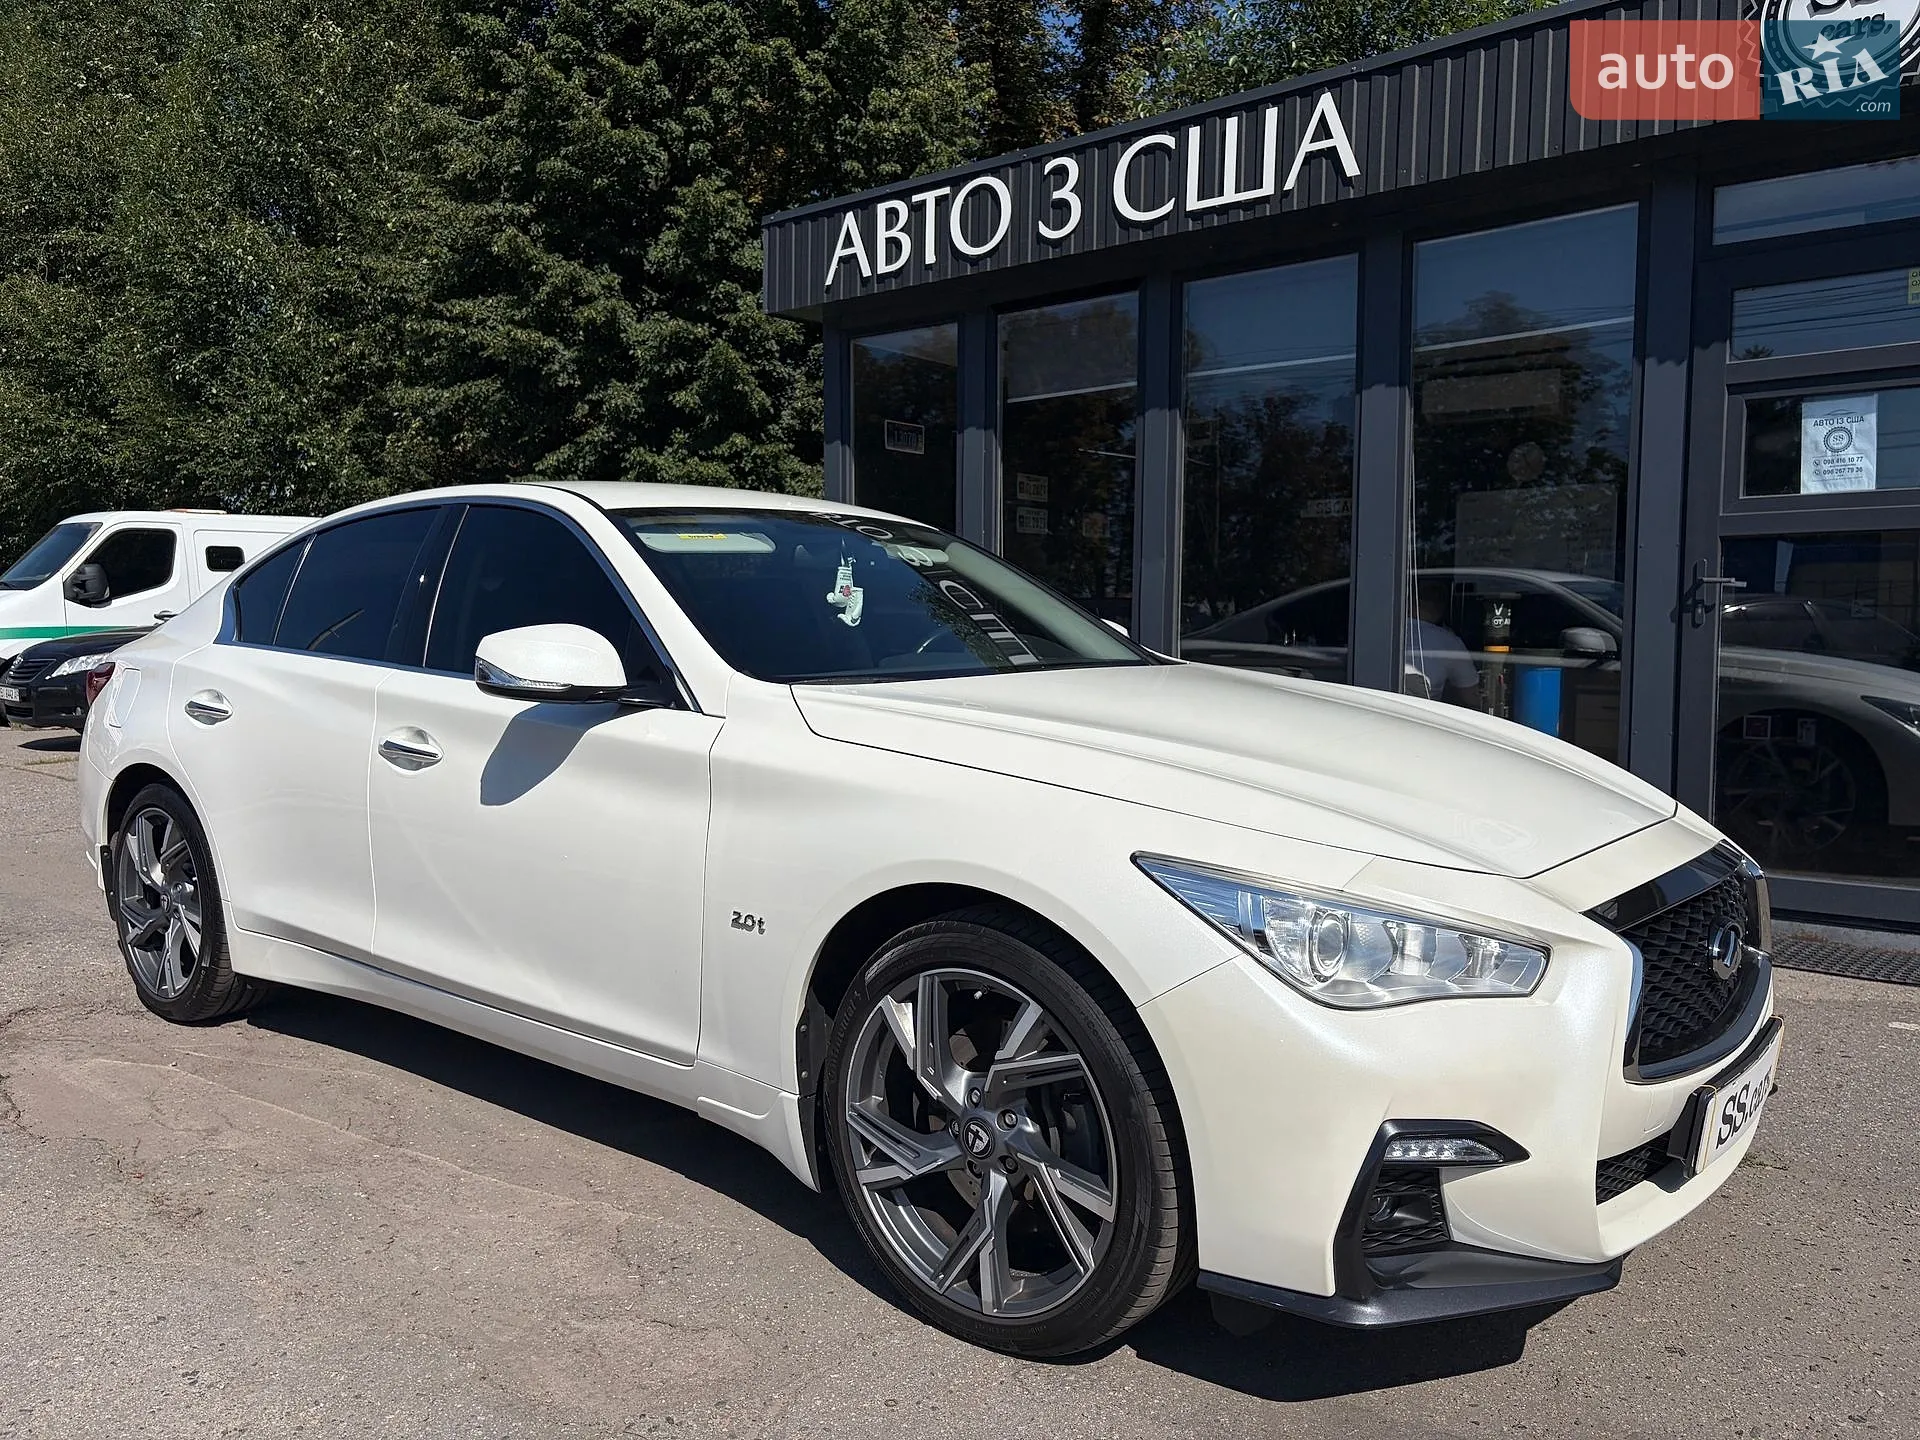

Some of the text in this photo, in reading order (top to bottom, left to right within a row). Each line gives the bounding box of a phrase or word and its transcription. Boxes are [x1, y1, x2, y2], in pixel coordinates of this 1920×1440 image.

[824, 91, 1361, 287] АВТО З США
[1813, 418, 1834, 427] АВТО
[1846, 415, 1865, 424] США
